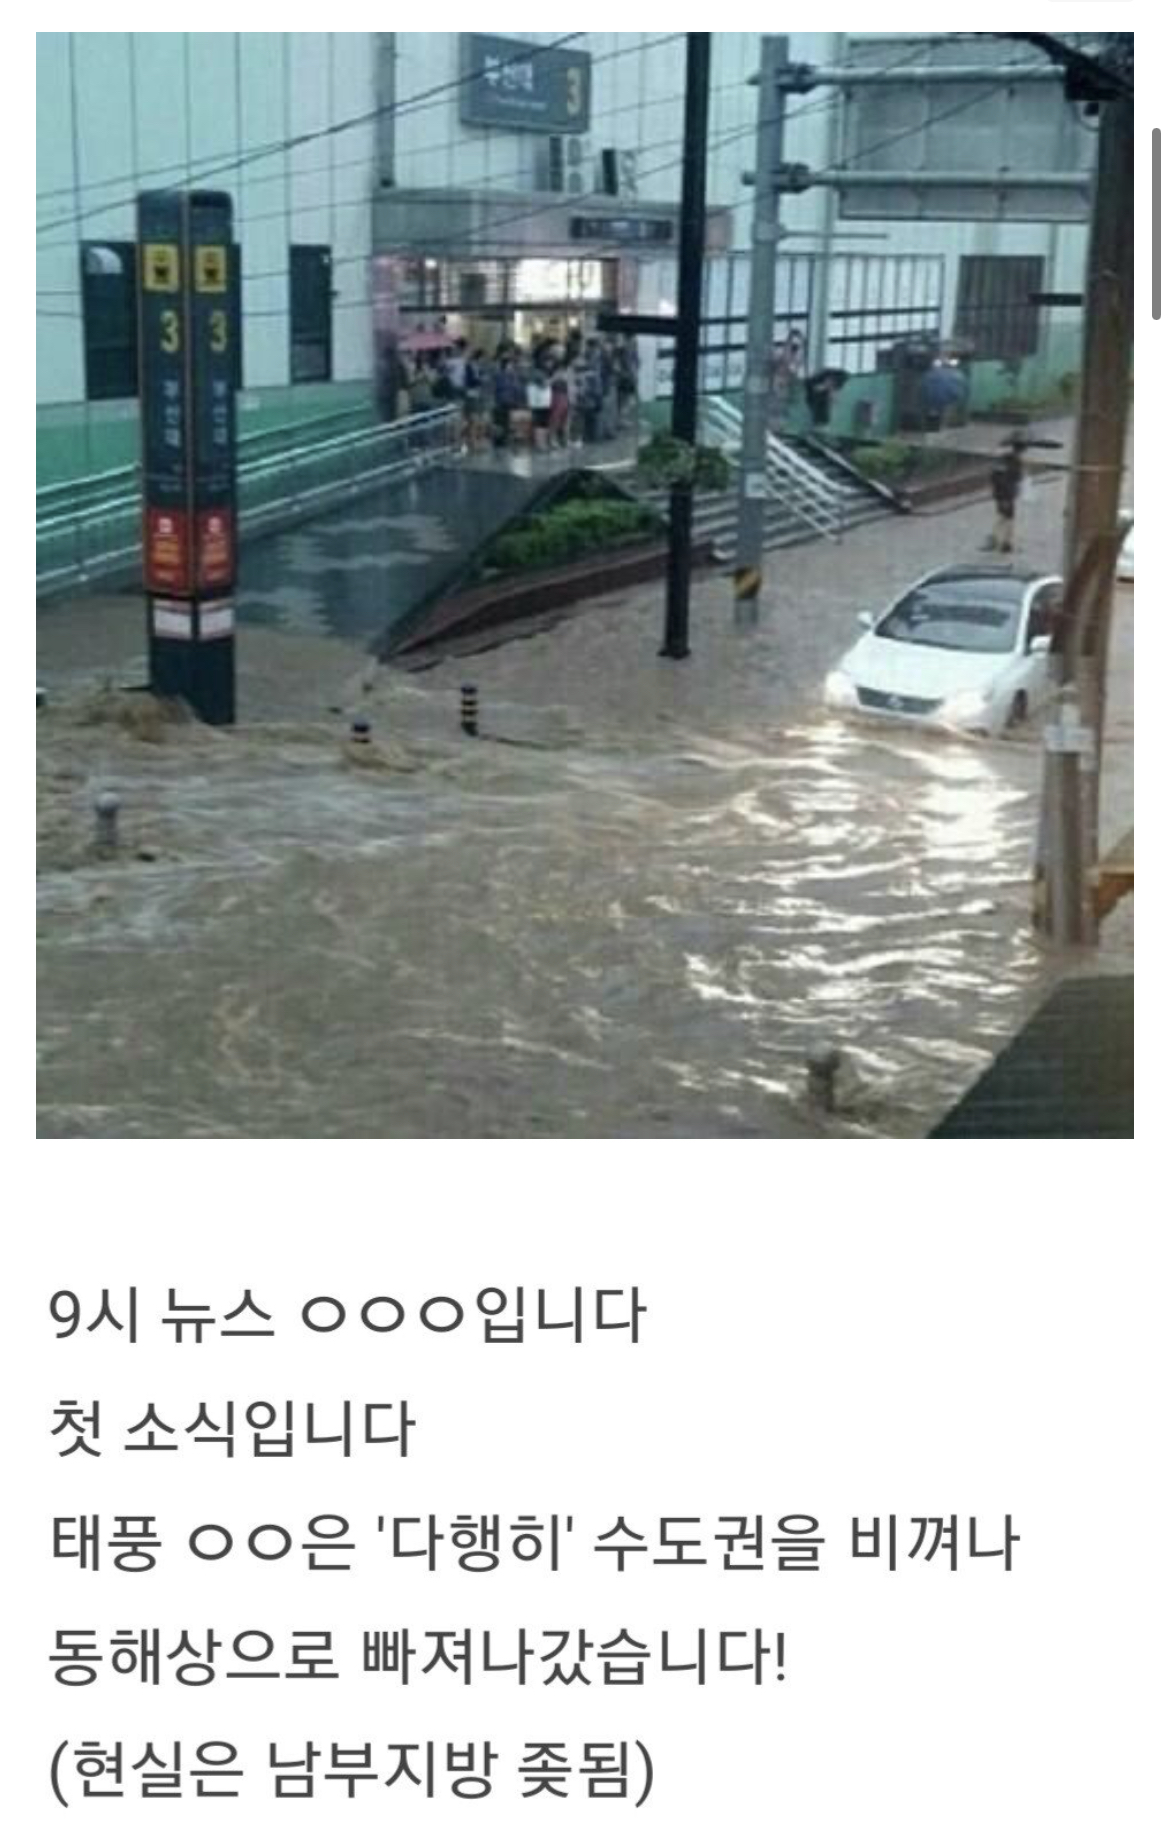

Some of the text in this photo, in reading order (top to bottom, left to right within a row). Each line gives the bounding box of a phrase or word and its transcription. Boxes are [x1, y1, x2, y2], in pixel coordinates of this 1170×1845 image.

[566, 67, 582, 117] 3
[160, 310, 179, 353] 3
[210, 310, 227, 353] 3
